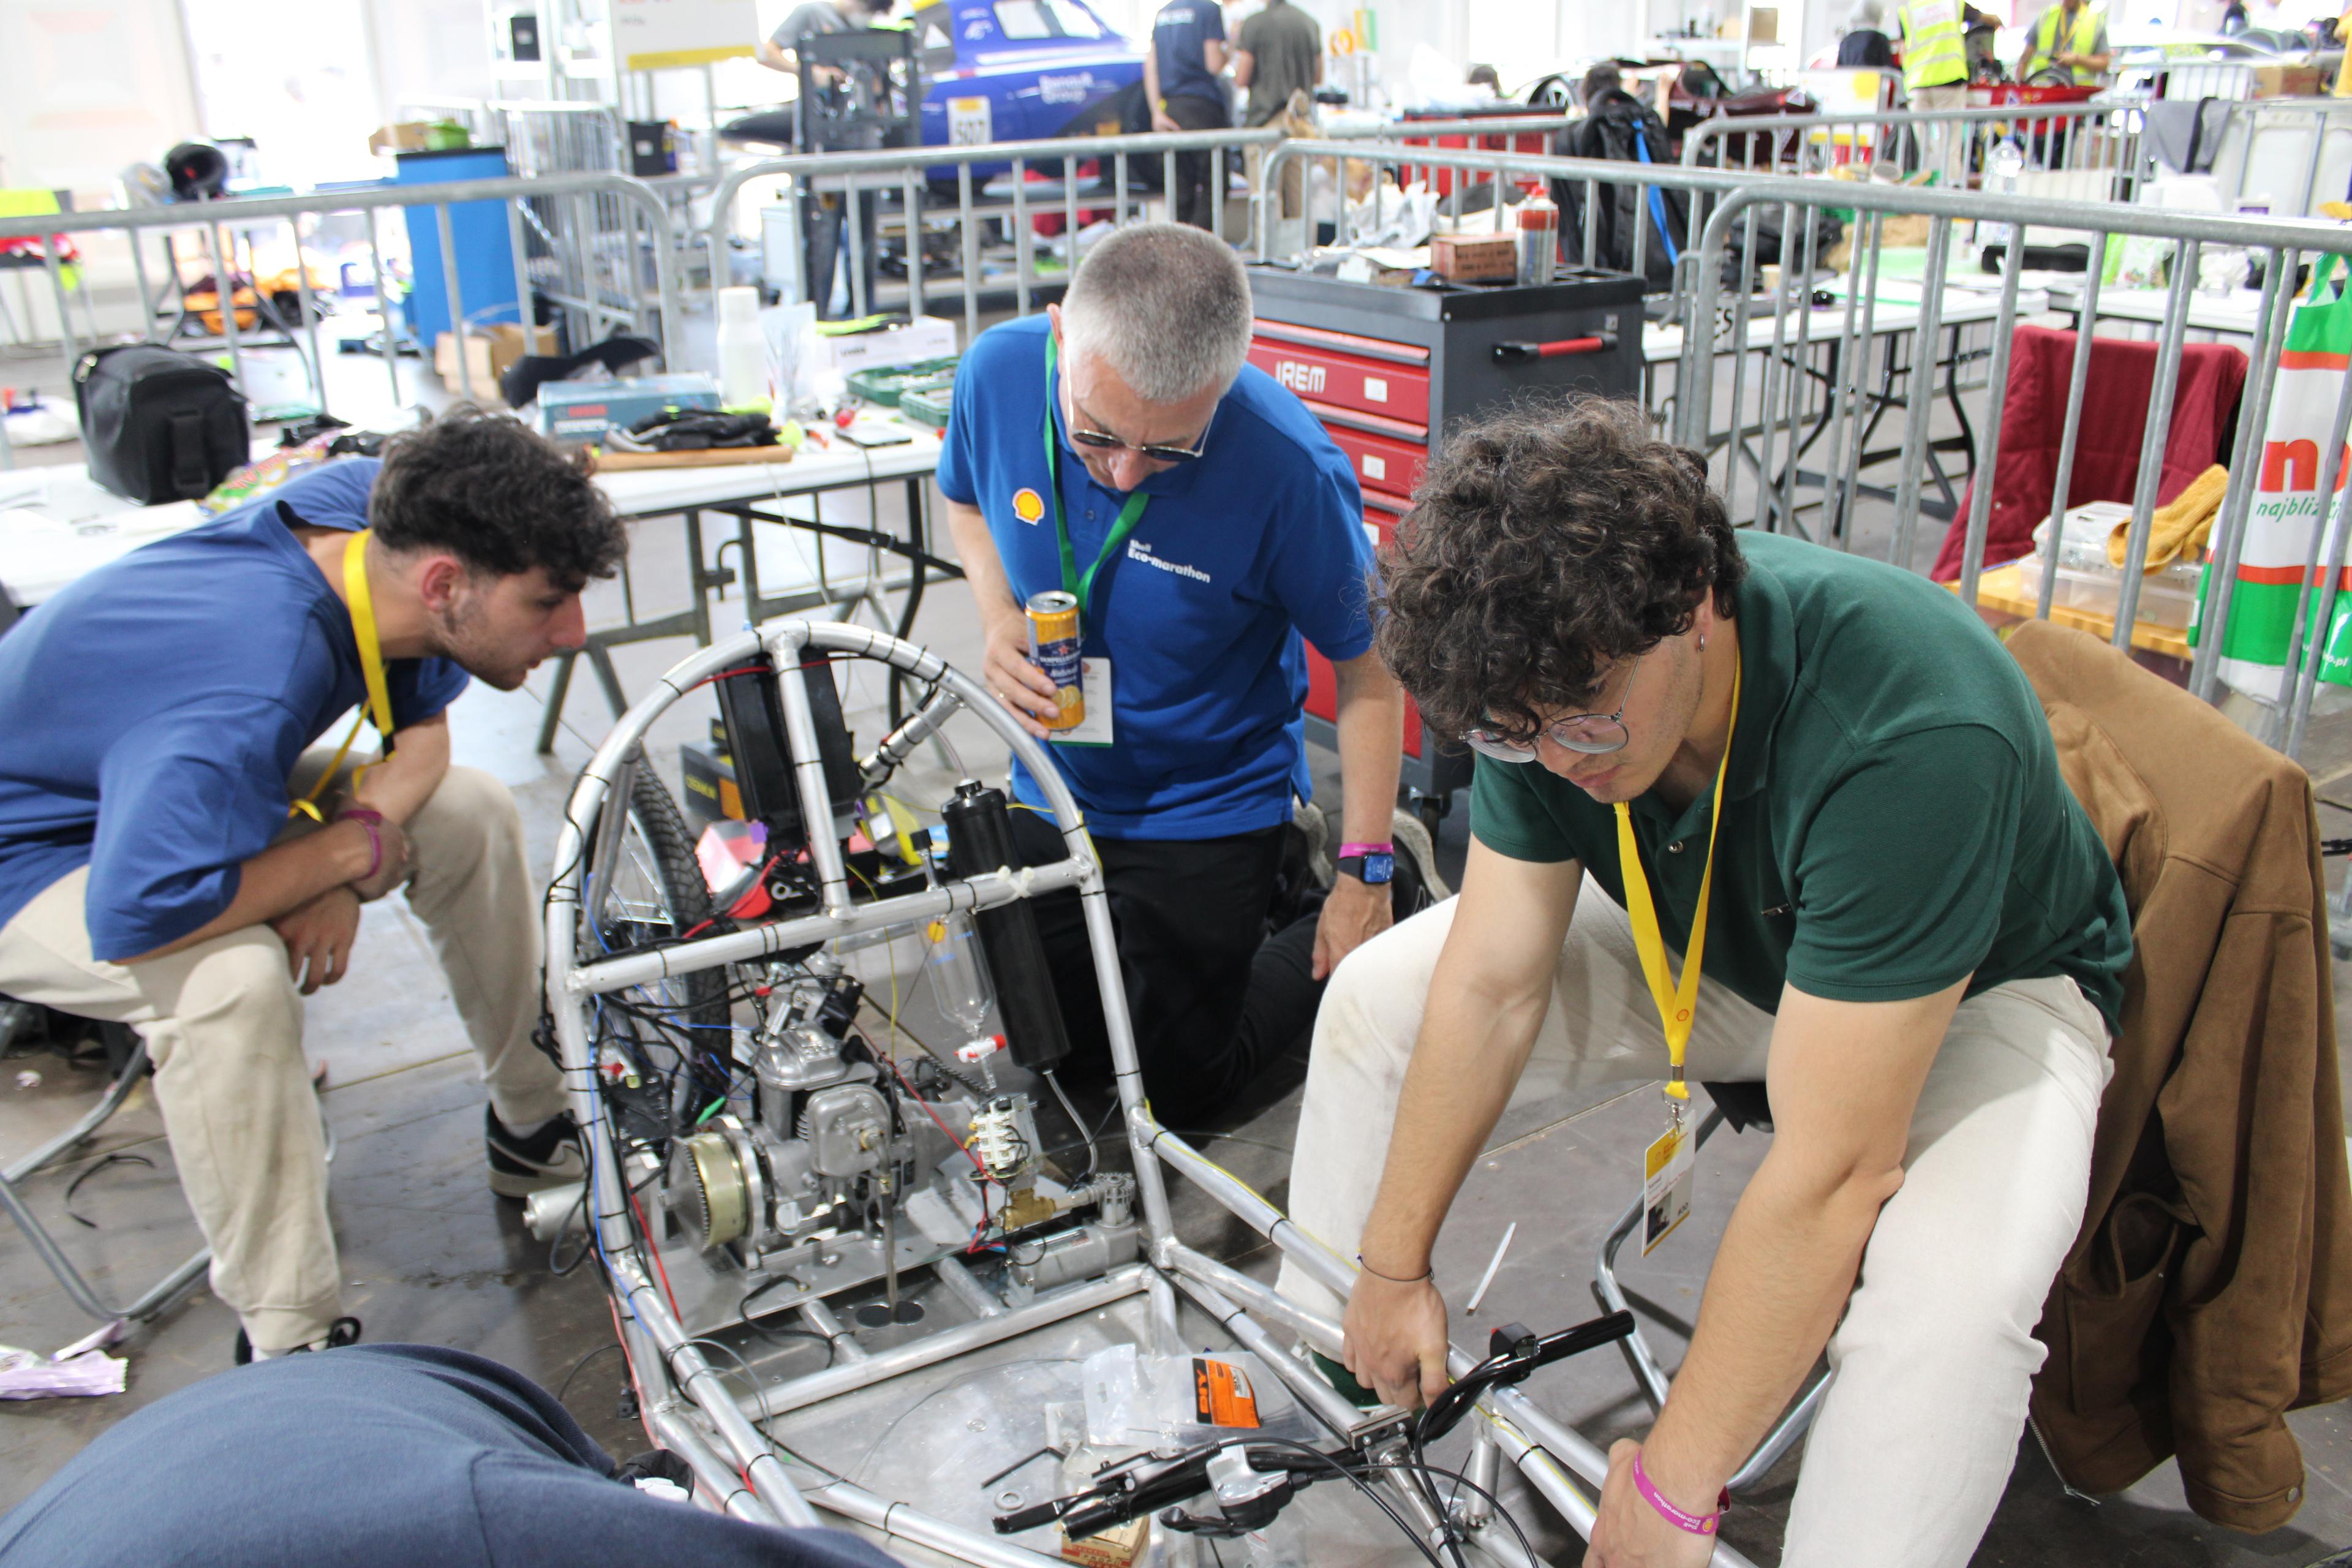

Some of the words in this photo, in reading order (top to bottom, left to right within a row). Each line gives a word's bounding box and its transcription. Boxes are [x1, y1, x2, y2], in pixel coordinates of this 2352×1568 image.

[1129, 539, 1152, 552] Shell
[1128, 548, 1210, 583] Eco-marathon
[1654, 1492, 1701, 1526] Eco-marathon
